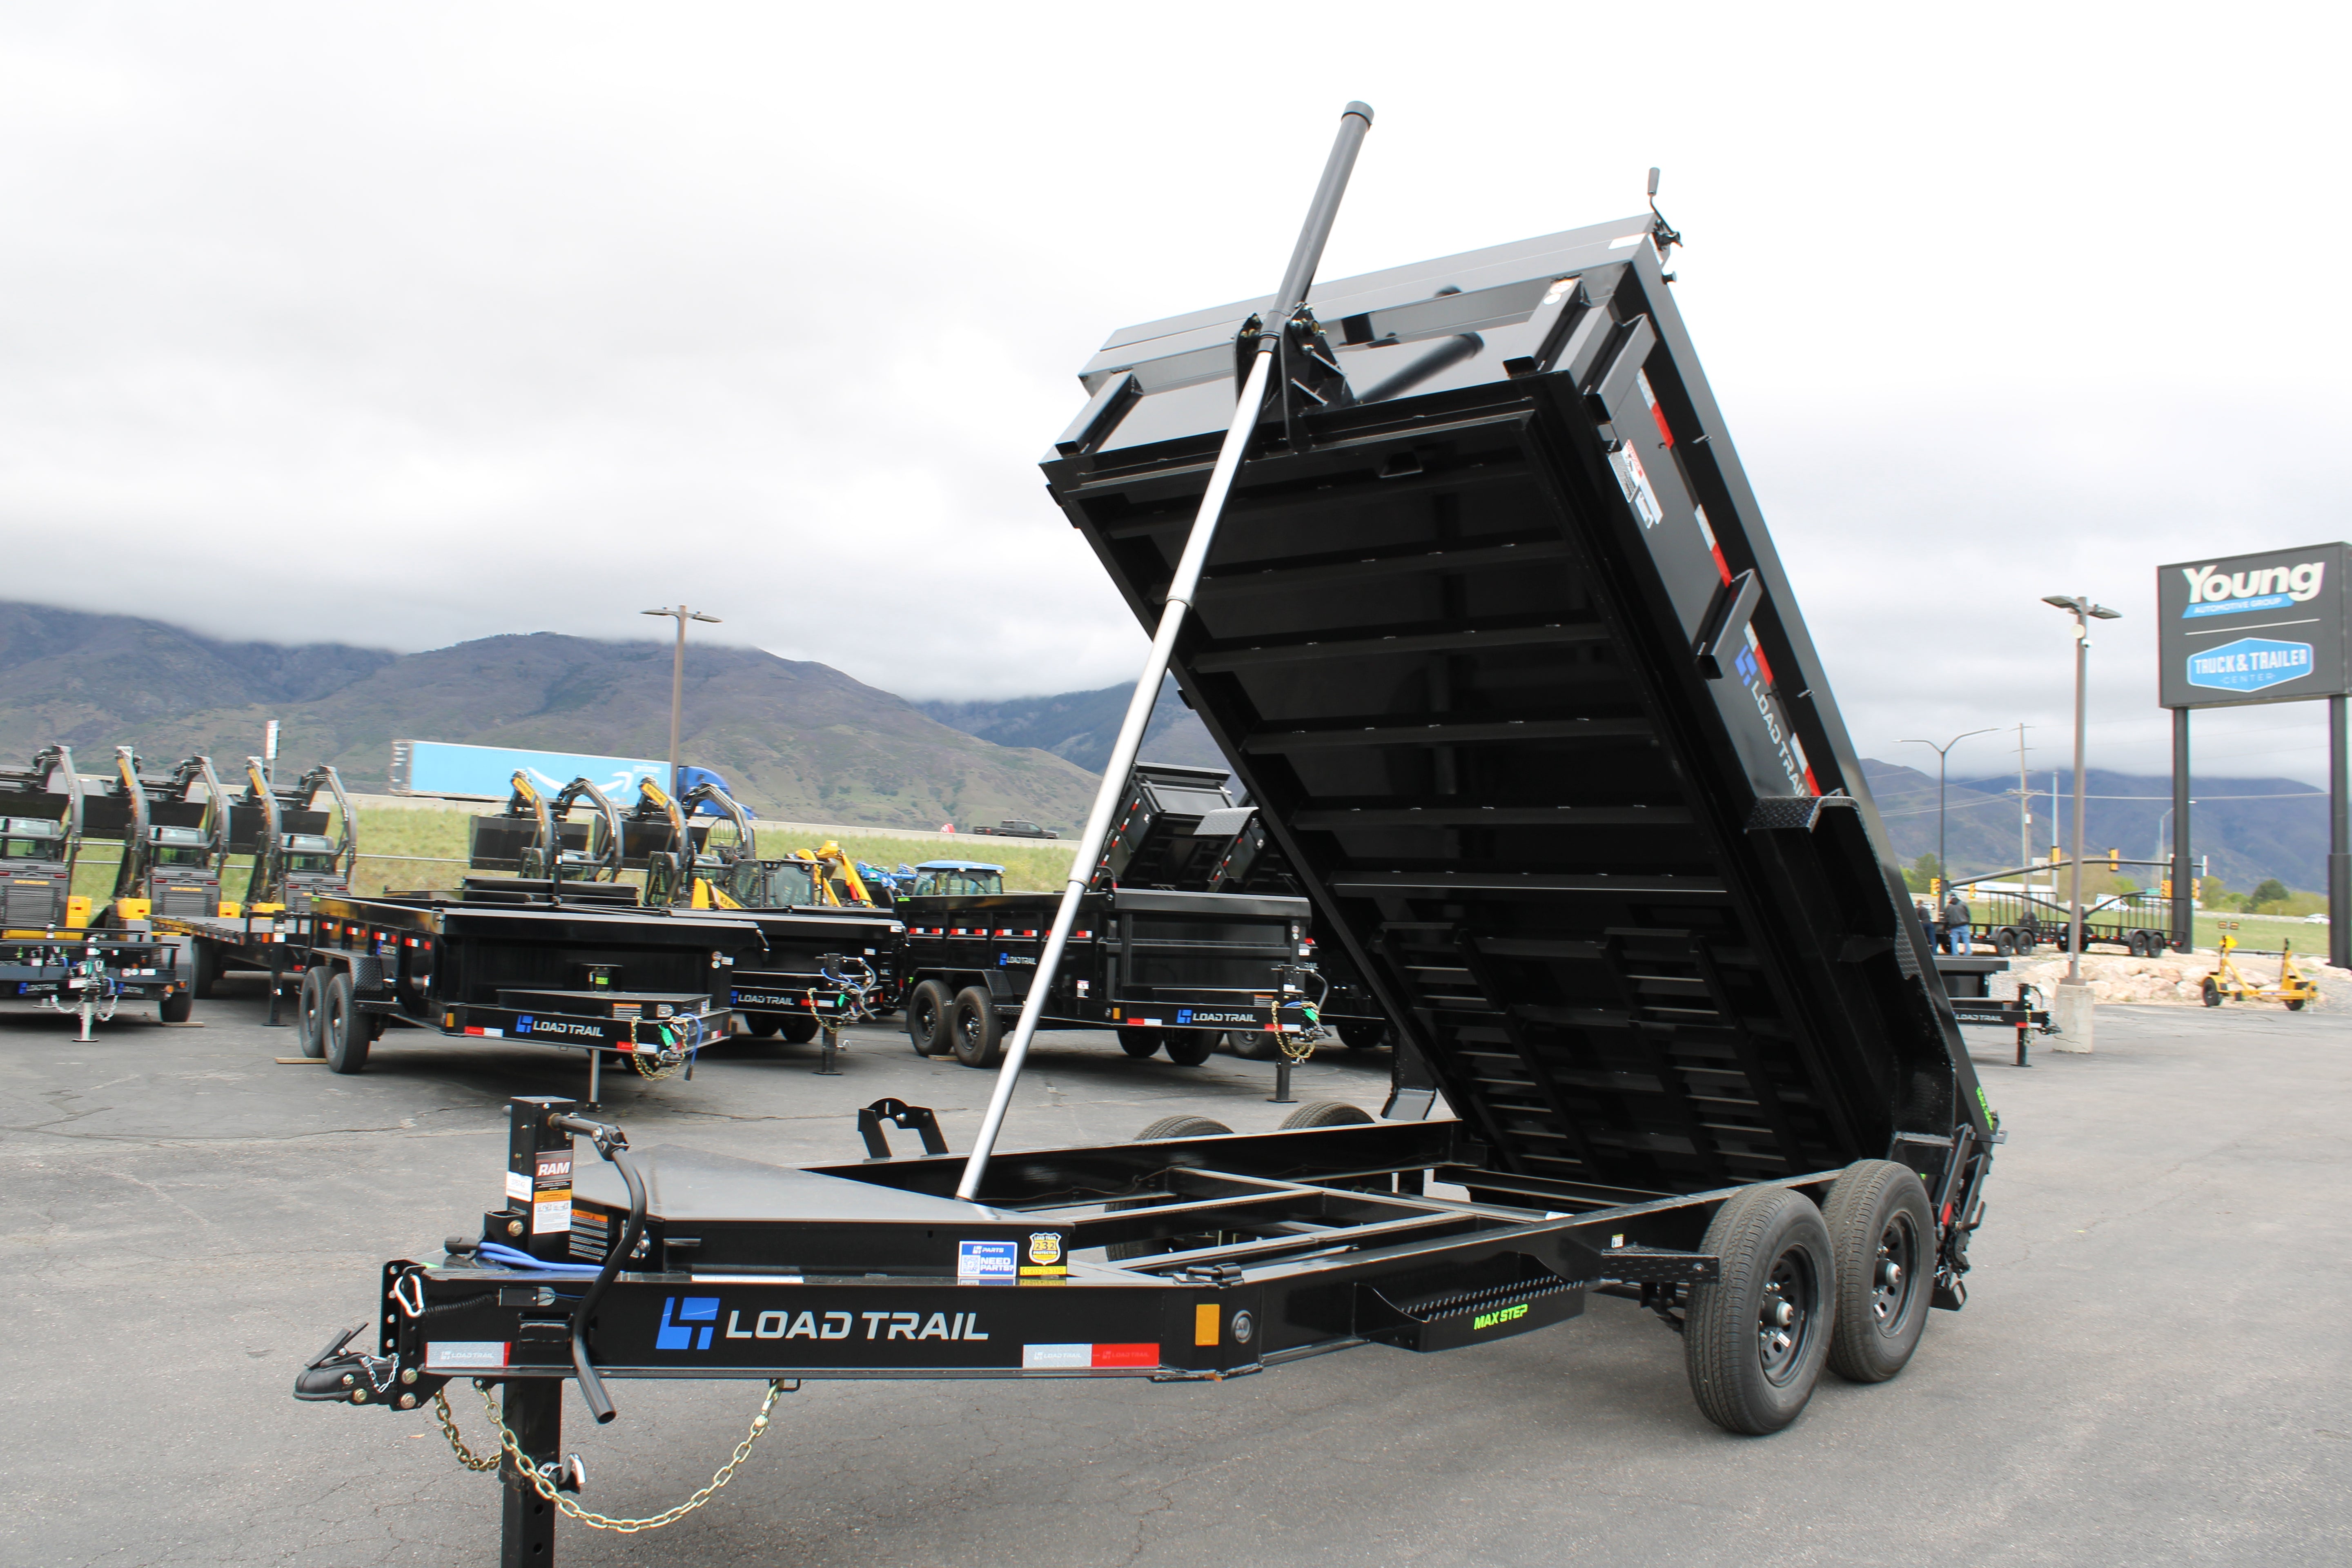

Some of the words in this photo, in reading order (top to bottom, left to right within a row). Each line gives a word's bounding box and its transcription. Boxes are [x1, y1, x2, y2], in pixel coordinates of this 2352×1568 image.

[2182, 562, 2325, 603] Young
[2194, 601, 2249, 614] AUTOMOTIVE
[2250, 597, 2282, 608] GROUP
[2194, 655, 2235, 674] TRUCK
[2250, 649, 2307, 670] TRAILER
[1751, 680, 1782, 744] LOAD
[1778, 741, 1806, 797] TRAI
[738, 994, 765, 1003] LOAD
[766, 996, 795, 1005] TRAIL
[1224, 1013, 1256, 1022] TRAIL
[533, 1021, 566, 1033] LOAD
[568, 1024, 604, 1037] TRAIL
[537, 1162, 571, 1176] RAM
[1036, 1242, 1054, 1250] 232
[1474, 1311, 1500, 1330] MAX
[1500, 1303, 1528, 1322] STEP
[726, 1311, 852, 1339] LOAD
[862, 1312, 989, 1340] TRAIL
